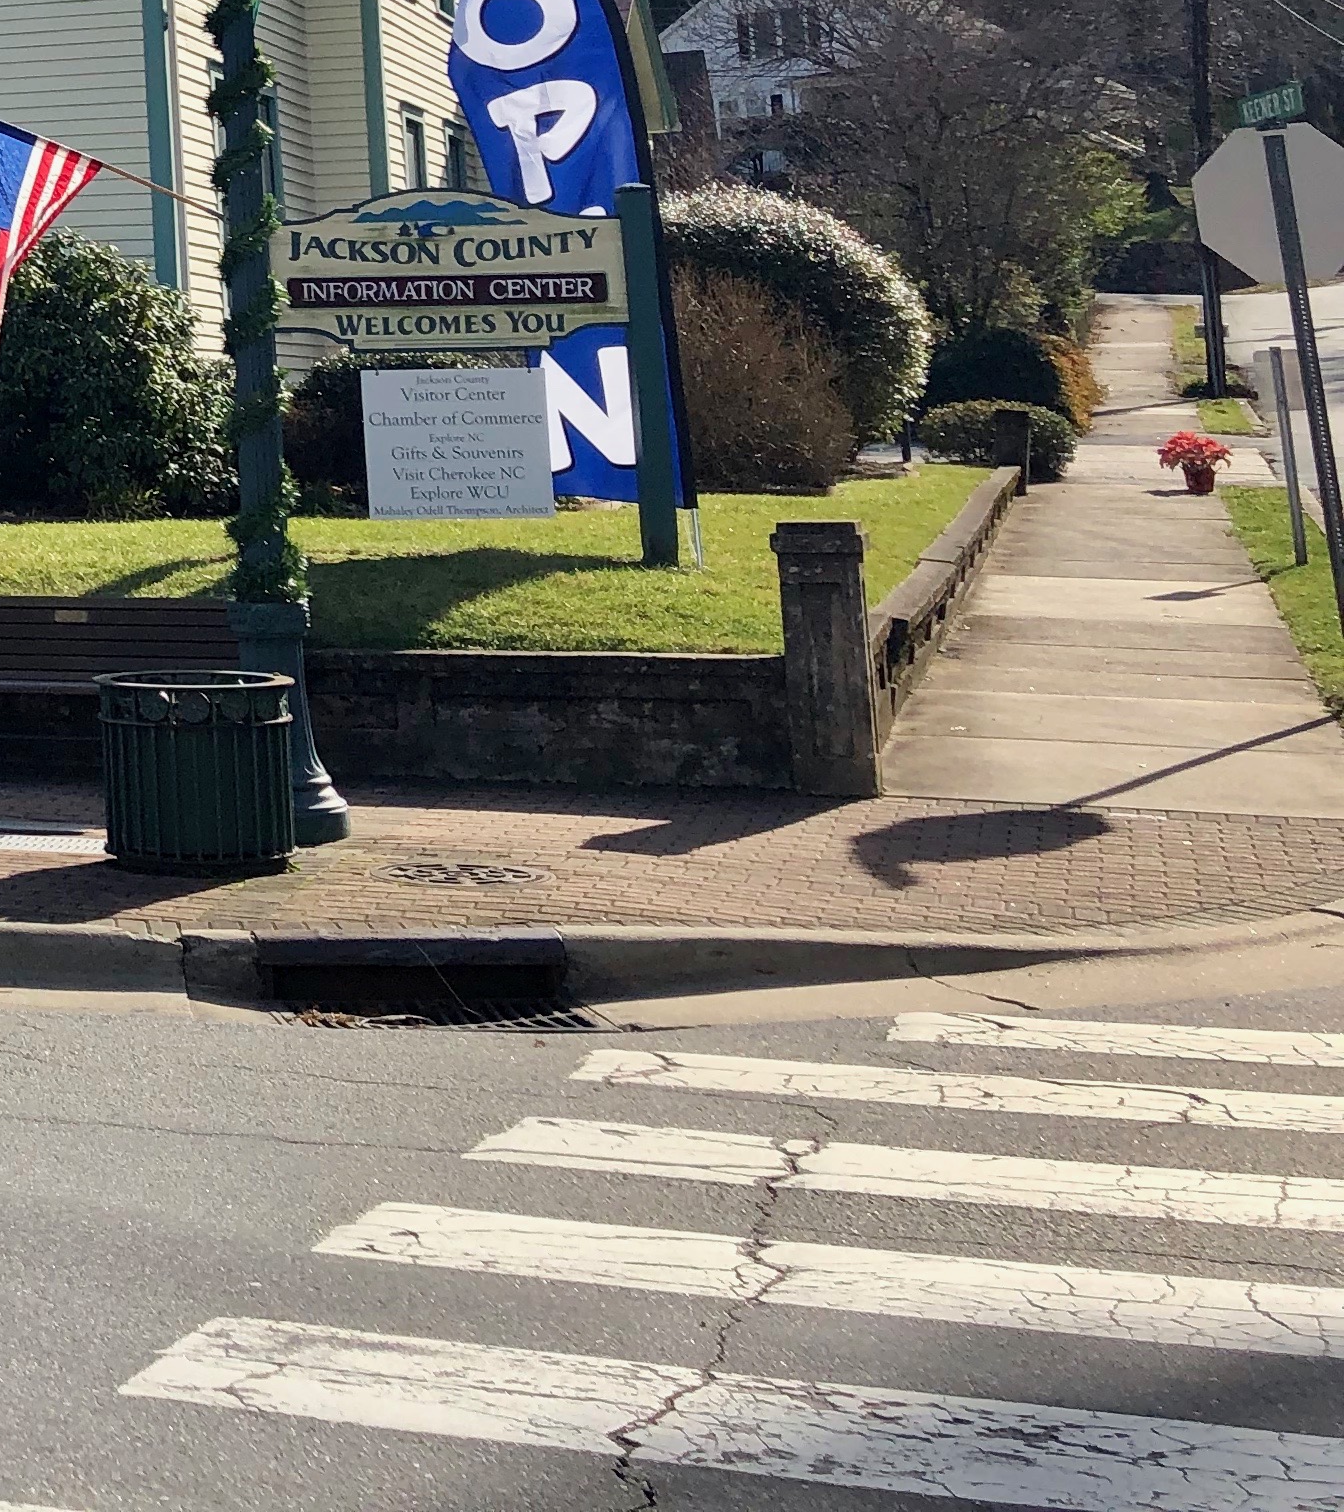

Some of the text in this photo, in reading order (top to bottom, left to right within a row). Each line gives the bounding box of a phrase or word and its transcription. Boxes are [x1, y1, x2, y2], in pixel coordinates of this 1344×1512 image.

[288, 226, 599, 268] JACKSON COUNTY
[301, 277, 595, 303] INFORMATION CENTER
[335, 311, 566, 336] WELCOMES YOU
[416, 375, 489, 385] Jackson County
[400, 386, 506, 402] Visitor Center
[368, 411, 543, 427] Chamber of Commerce
[429, 433, 485, 444] Explore NC
[391, 445, 524, 461] Gifts & Souvenirs
[392, 466, 526, 481] Visit Cherokee NC
[410, 485, 510, 502] Explore WCU
[505, 504, 549, 514] Architect
